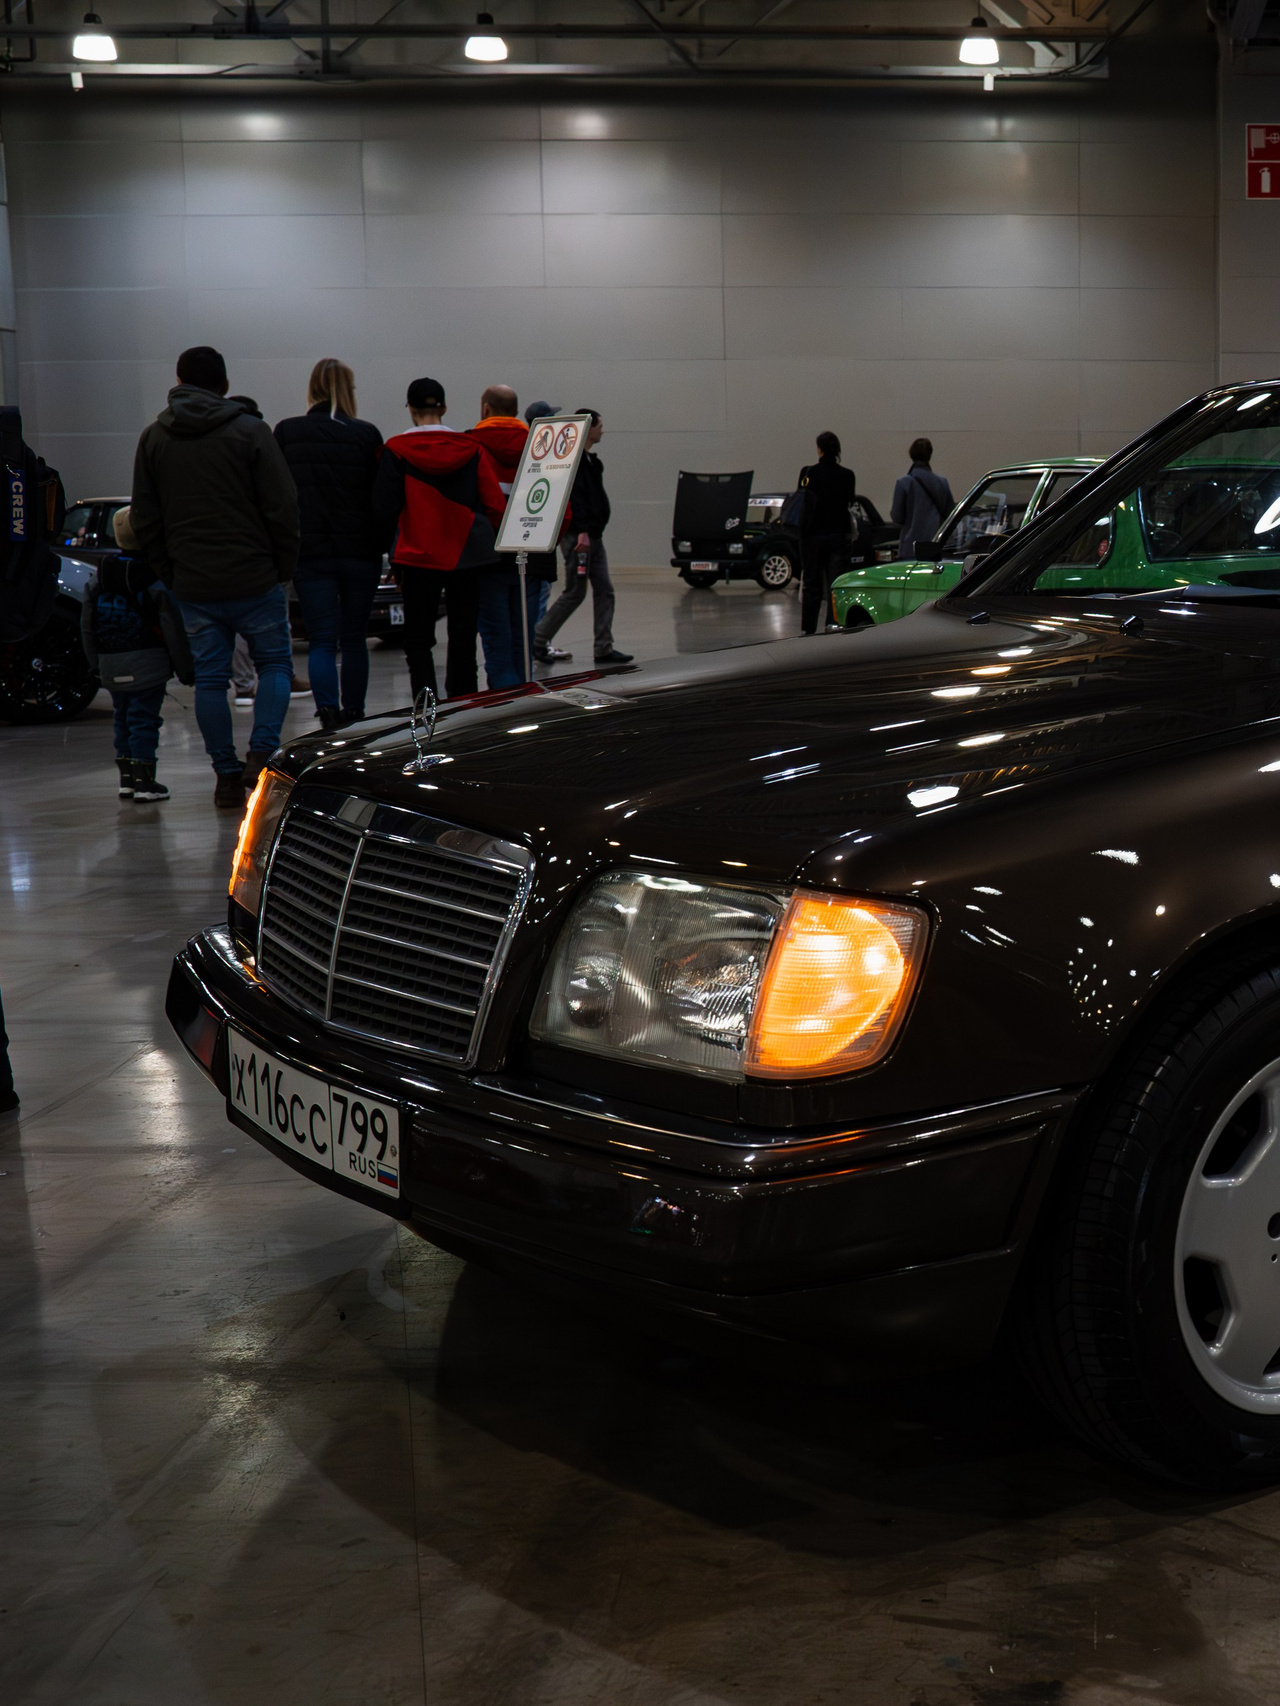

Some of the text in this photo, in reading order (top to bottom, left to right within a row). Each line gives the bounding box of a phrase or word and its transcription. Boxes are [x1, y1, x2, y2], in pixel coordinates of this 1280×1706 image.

[11, 481, 25, 536] CREW
[332, 1092, 389, 1161] 799
[348, 1151, 377, 1179] RUS
